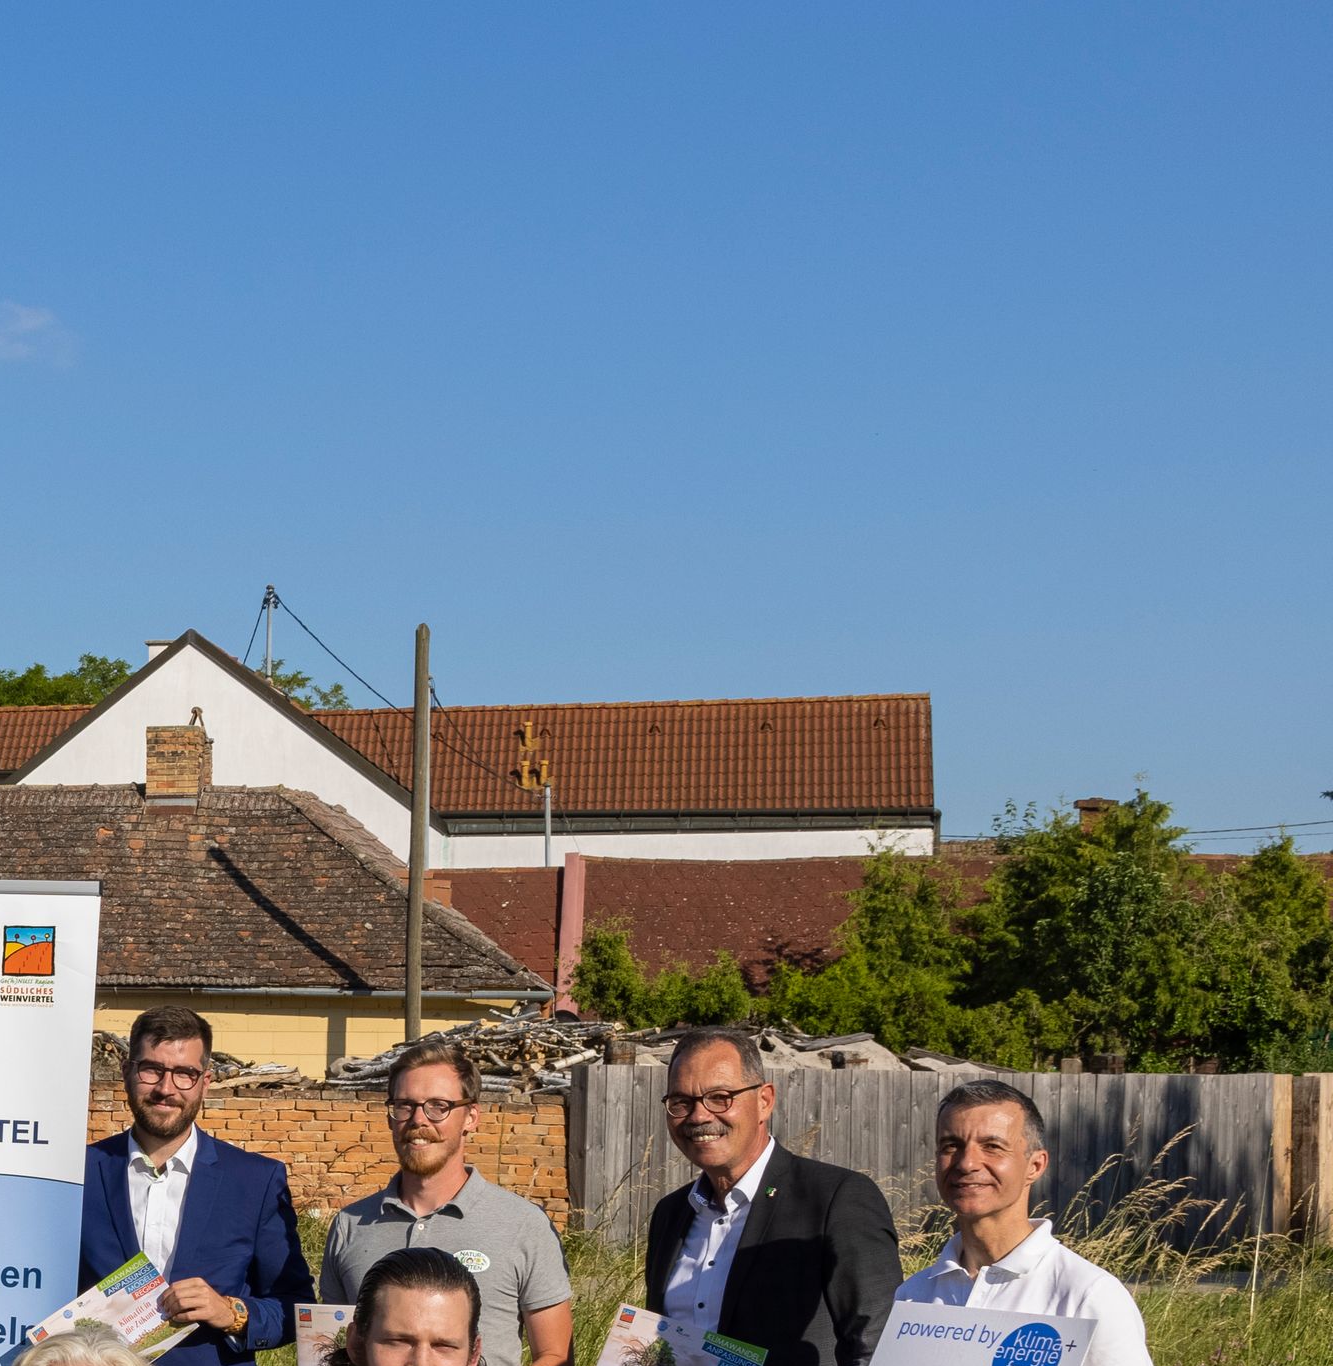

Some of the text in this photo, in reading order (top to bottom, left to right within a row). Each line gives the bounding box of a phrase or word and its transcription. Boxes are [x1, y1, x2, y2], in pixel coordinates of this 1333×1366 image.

[0, 985, 53, 994] SÜDLICHES
[134, 1279, 161, 1298] REGION
[897, 1321, 1002, 1348] powered by
[1014, 1329, 1062, 1351] klima
